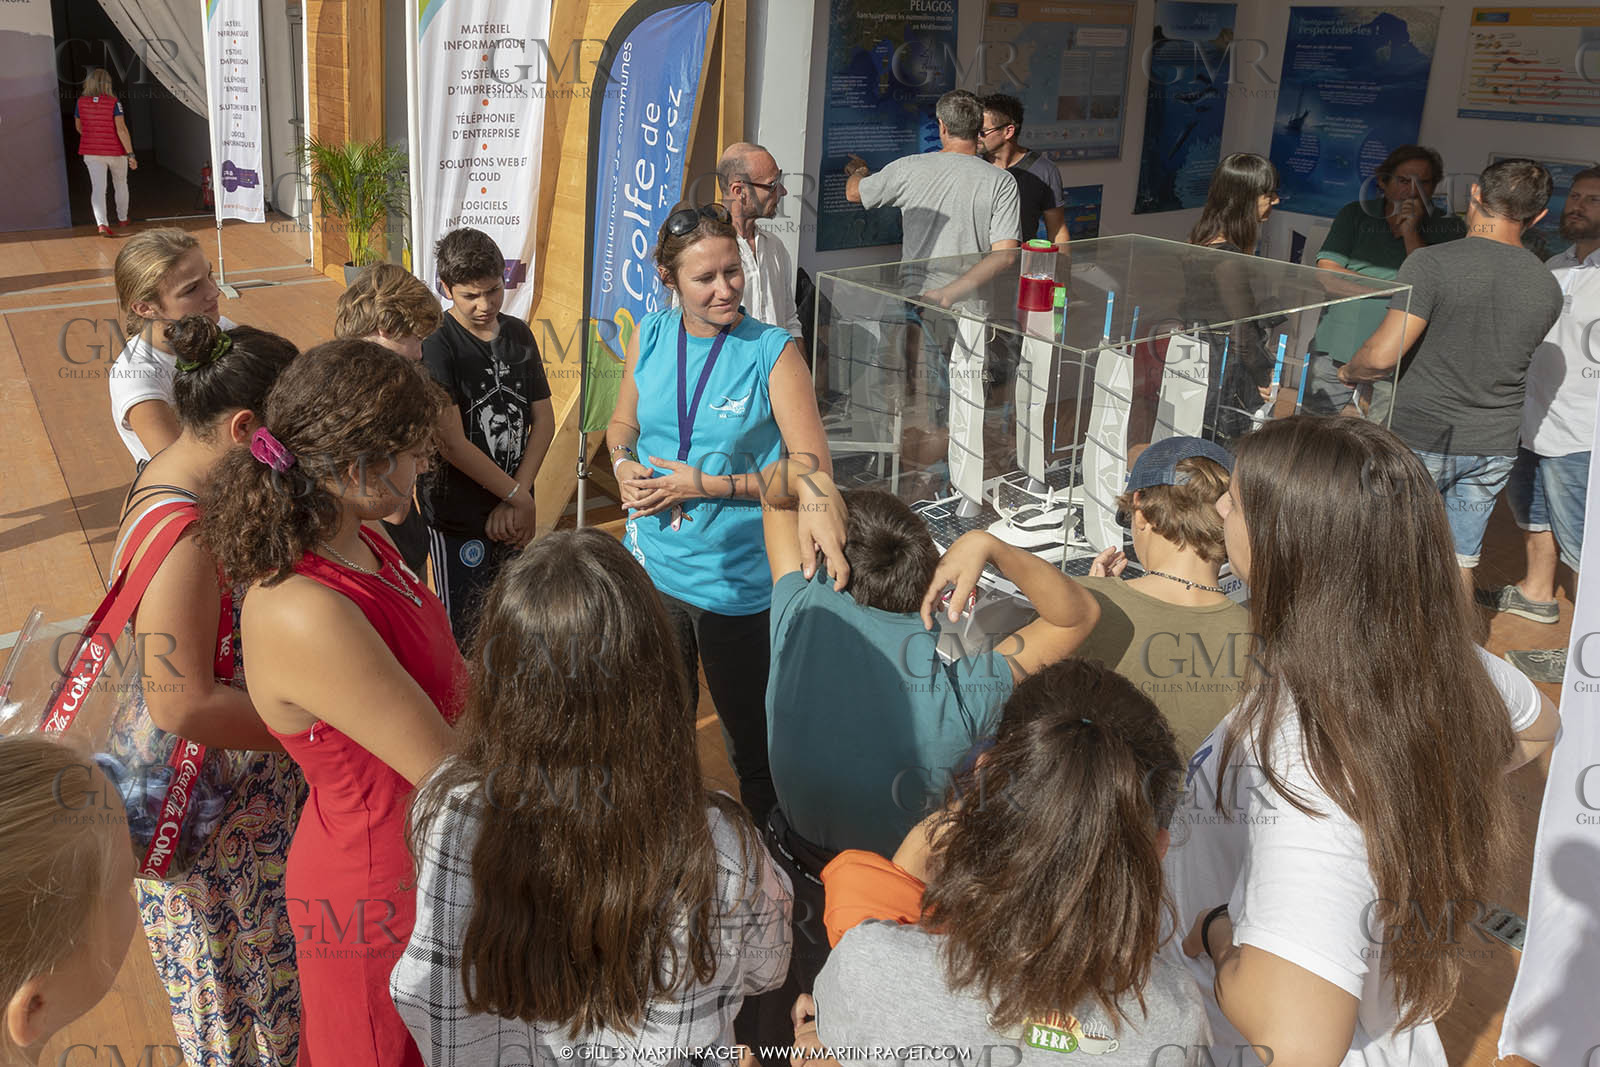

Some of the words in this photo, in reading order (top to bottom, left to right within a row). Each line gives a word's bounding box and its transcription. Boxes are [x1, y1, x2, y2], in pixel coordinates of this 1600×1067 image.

[461, 21, 510, 34] MATÉRIEL
[444, 39, 525, 50] INFORMATIQUE
[461, 66, 510, 79] SYSTÈMES
[456, 112, 515, 124] TÉLÉPHONIE
[452, 128, 520, 140] D'ENTREPRISE
[440, 157, 494, 170] SOLUTIONS
[497, 158, 519, 167] WEB
[469, 172, 501, 182] CLOUD
[461, 201, 508, 211] LOGICIELS
[622, 158, 655, 301] Golfe
[641, 102, 661, 146] de
[446, 215, 520, 228] INFORMATIQUES
[1031, 1025, 1072, 1050] PERK
